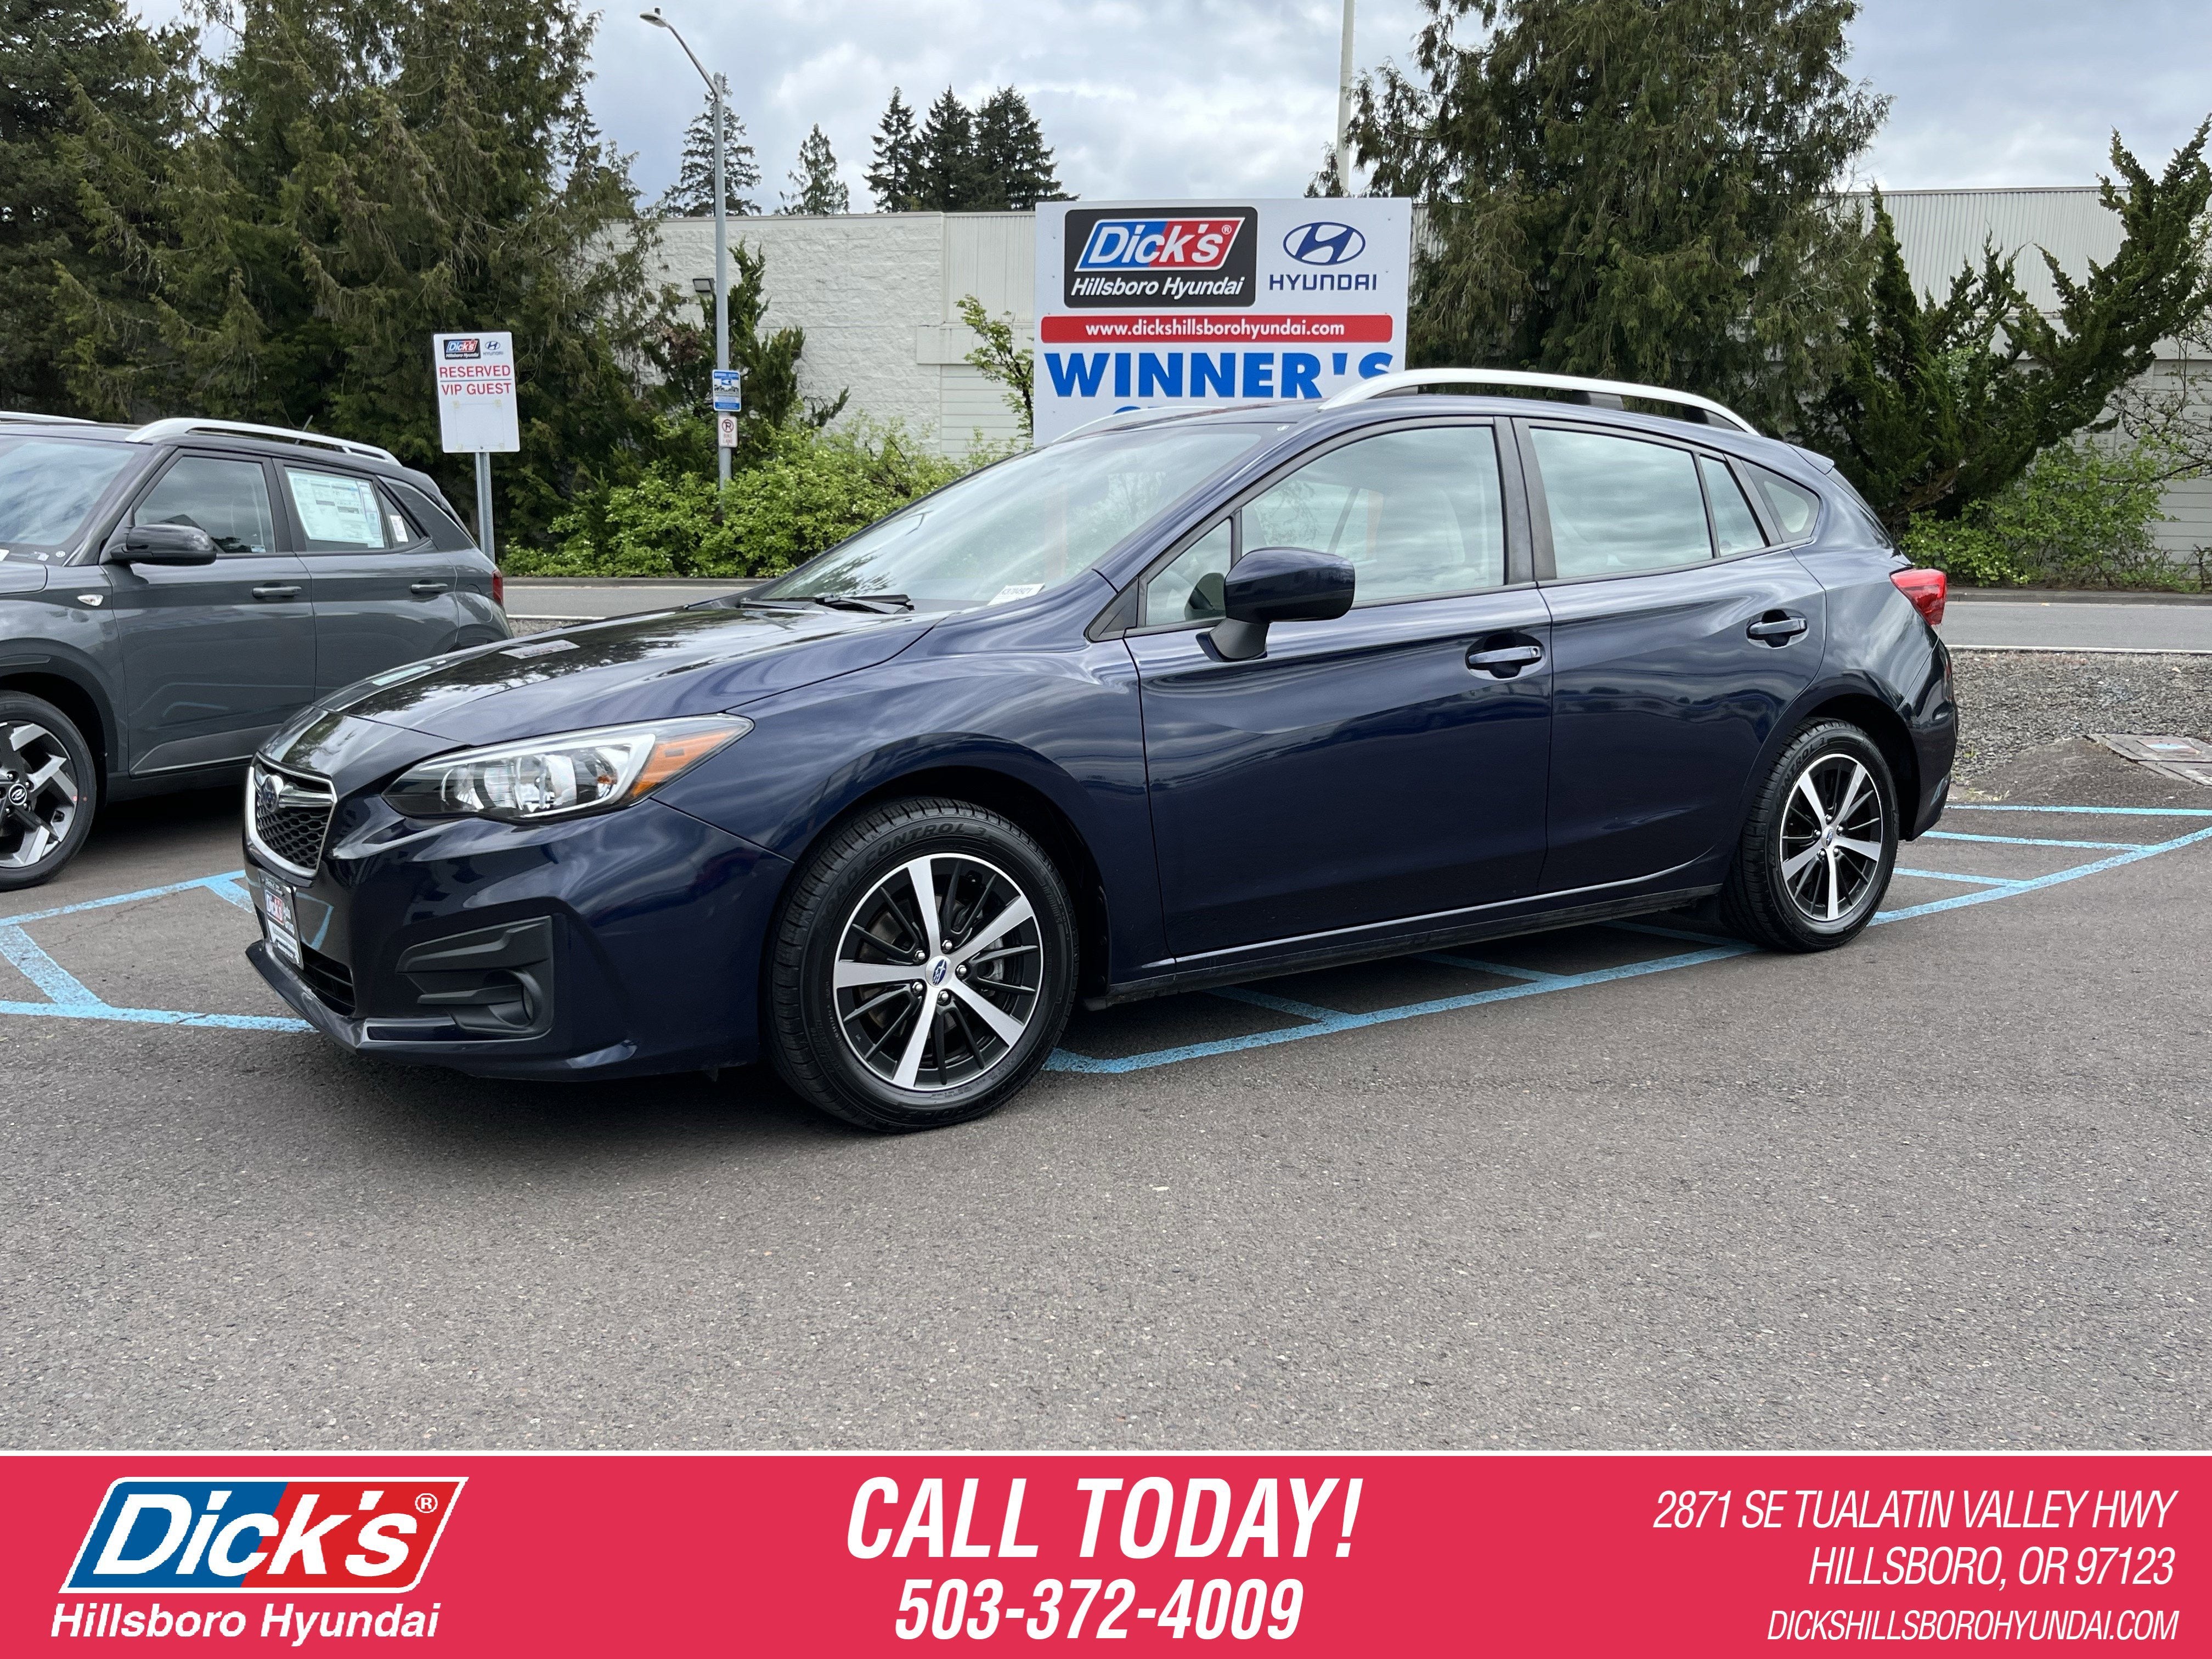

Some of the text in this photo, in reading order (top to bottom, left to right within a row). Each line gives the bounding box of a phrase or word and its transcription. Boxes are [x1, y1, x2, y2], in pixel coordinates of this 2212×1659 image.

[1088, 224, 1223, 263] Dick's
[1071, 276, 1245, 300] Hillsboro Hyundai
[1270, 274, 1378, 291] HYUNDAI
[1085, 318, 1345, 340] www.dickshillsborohyundai.com
[449, 341, 475, 351] Dick's
[439, 365, 511, 378] RESERVED
[1045, 352, 1393, 399] WINNER'S
[441, 382, 511, 395] VIP GUEST
[865, 823, 965, 866] CONTROL
